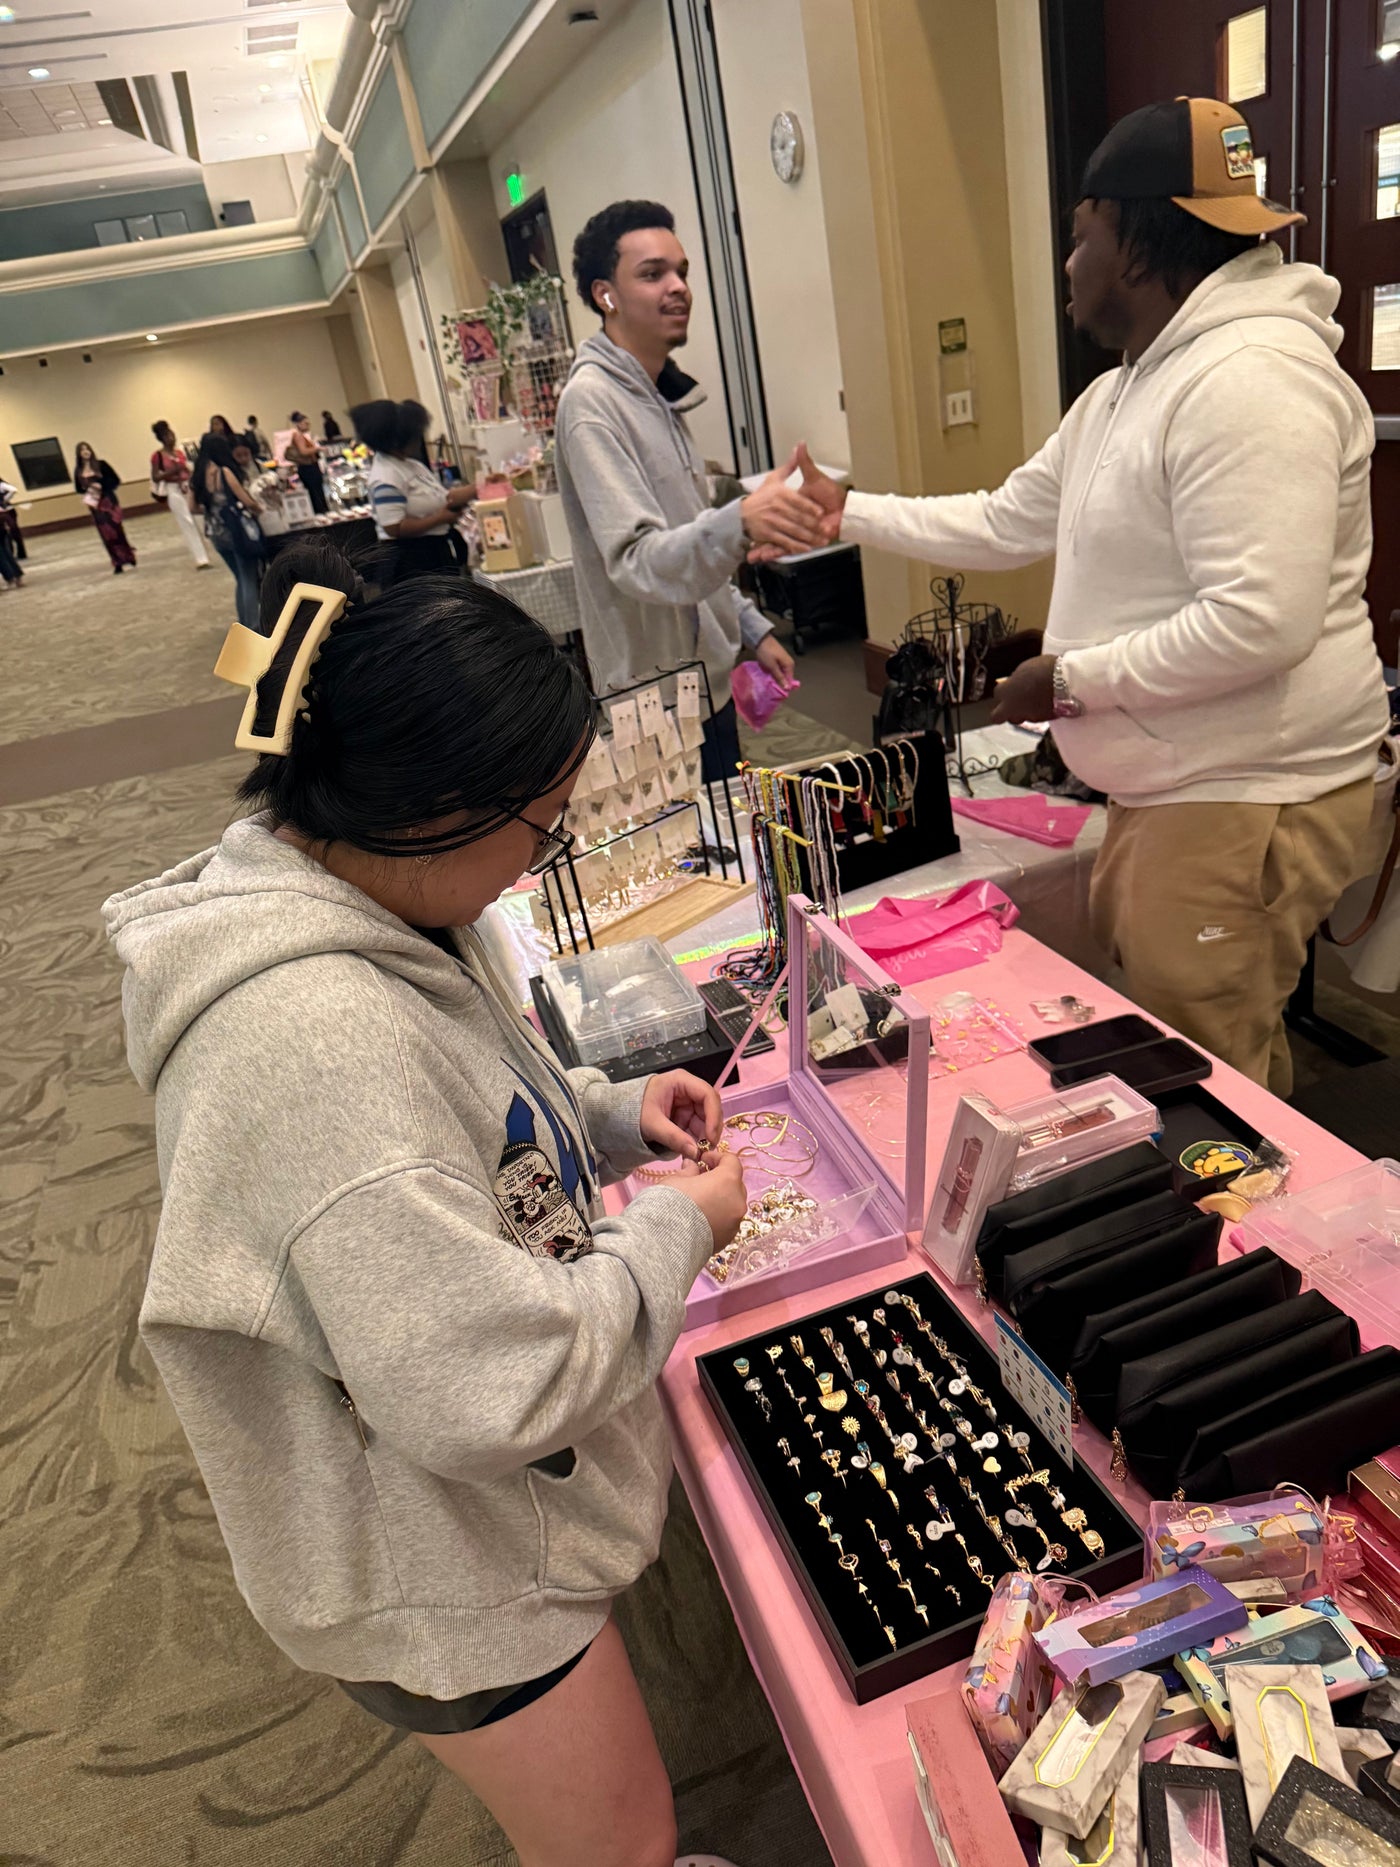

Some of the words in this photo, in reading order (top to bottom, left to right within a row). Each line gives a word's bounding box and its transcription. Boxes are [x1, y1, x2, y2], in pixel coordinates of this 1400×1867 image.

[503, 1177, 515, 1187] YOU
[515, 1161, 538, 1178] TRIED!
[505, 1181, 517, 1191] YOU
[518, 1167, 538, 1182] TRIED!
[527, 1230, 540, 1241] TOO
[532, 1234, 543, 1243] YOU
[543, 1225, 556, 1235] ASK
